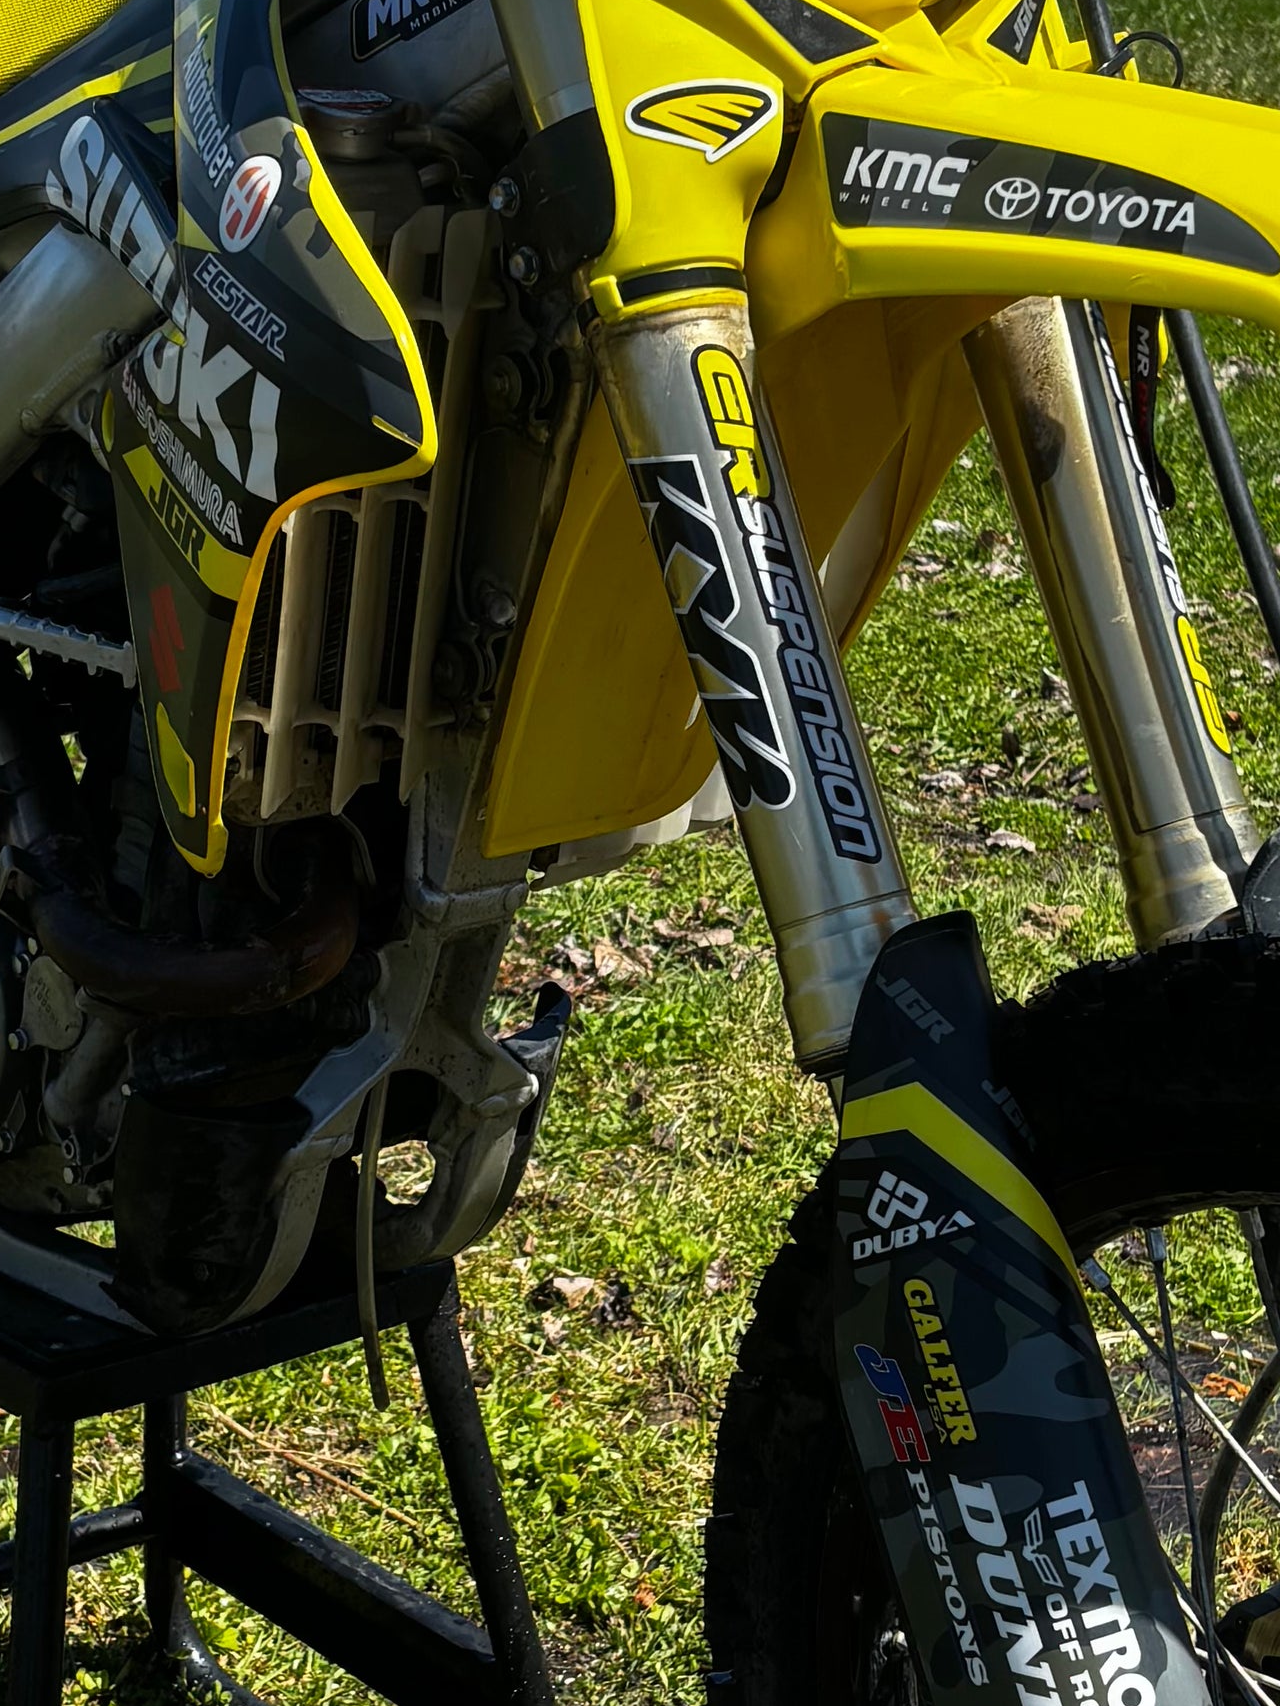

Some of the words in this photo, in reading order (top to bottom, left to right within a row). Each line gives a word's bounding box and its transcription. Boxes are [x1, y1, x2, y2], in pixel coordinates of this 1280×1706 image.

[184, 36, 236, 189] Autotrader
[839, 192, 952, 214] WHEELS
[842, 146, 969, 197] KMC
[1045, 187, 1195, 235] TOYOTA
[193, 253, 287, 362] ECSTAR
[1136, 325, 1150, 377] MR
[136, 387, 243, 545] YOSHIMURA
[147, 476, 207, 573] JGR
[737, 495, 878, 859] SUSPENSION
[875, 972, 955, 1044] JGR
[853, 1210, 975, 1261] DUBYA
[904, 1279, 977, 1444] GALFER
[924, 1384, 946, 1443] USA
[854, 1344, 931, 1462] JE
[905, 1467, 990, 1687] PISTONS
[1046, 1594, 1083, 1661] OFF
